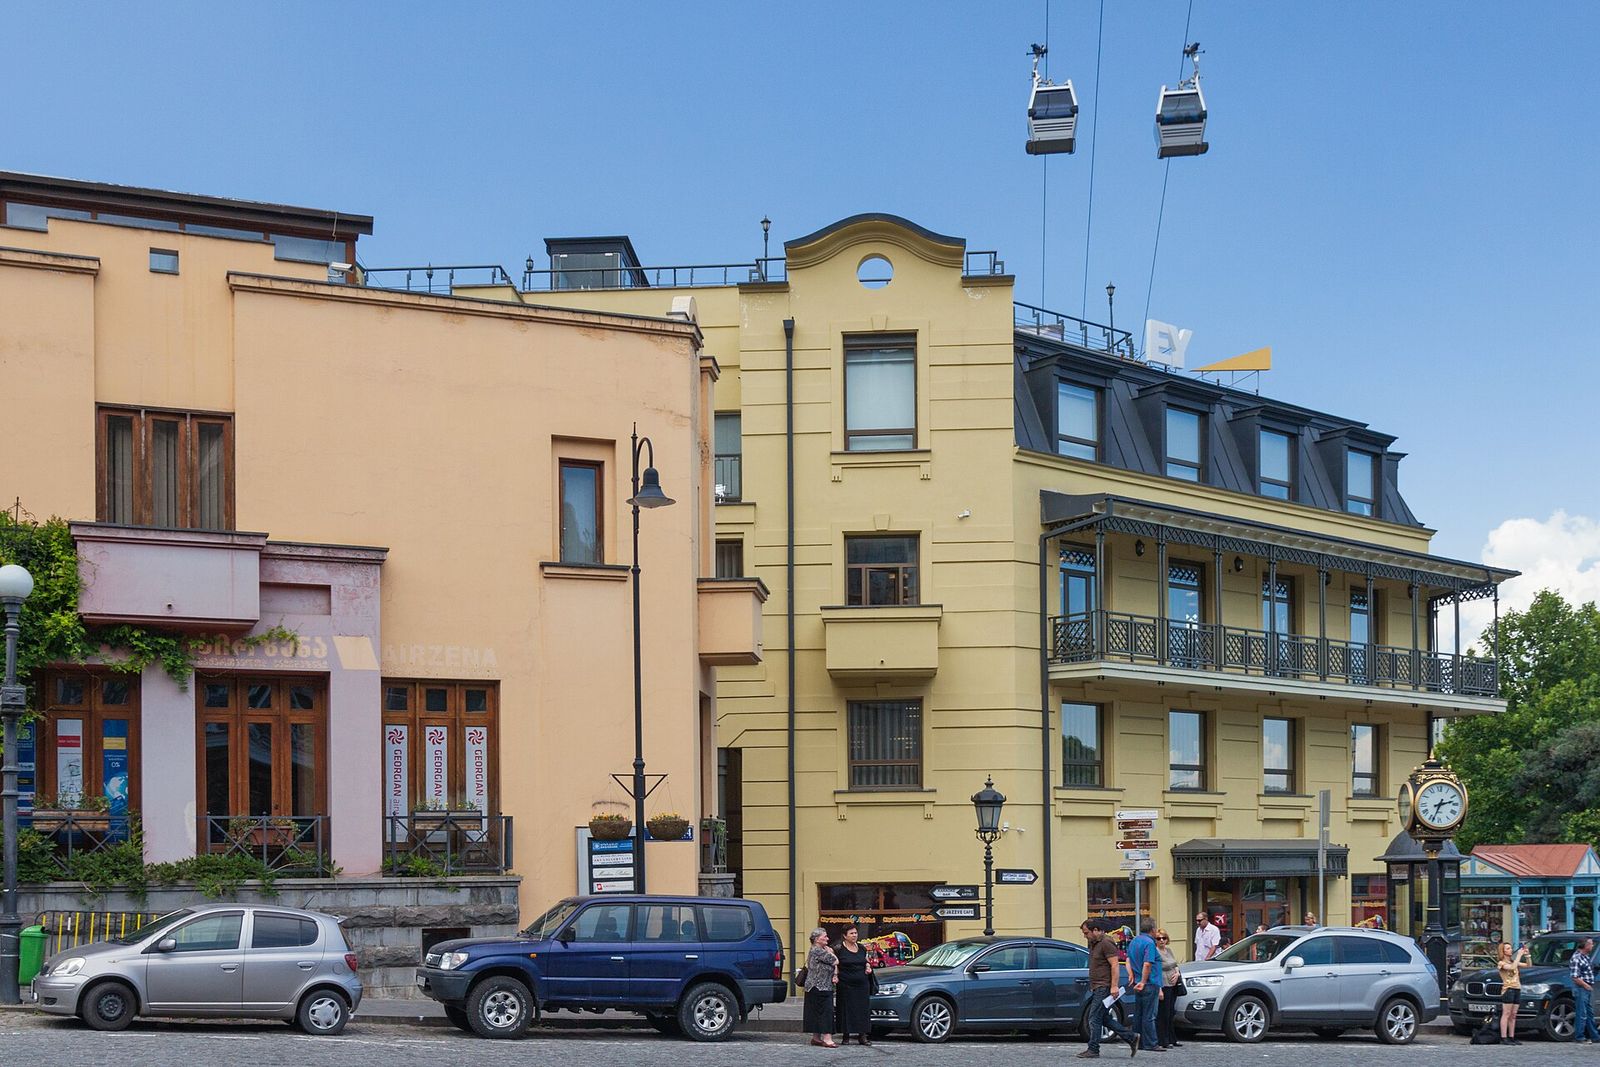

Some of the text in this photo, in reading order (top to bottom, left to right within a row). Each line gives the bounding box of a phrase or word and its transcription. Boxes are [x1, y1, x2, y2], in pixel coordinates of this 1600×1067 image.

[1145, 319, 1193, 369] EY
[393, 749, 403, 797] GEORGIAN
[434, 749, 443, 797] GEORGIAN
[474, 749, 484, 796] GEORGIAN
